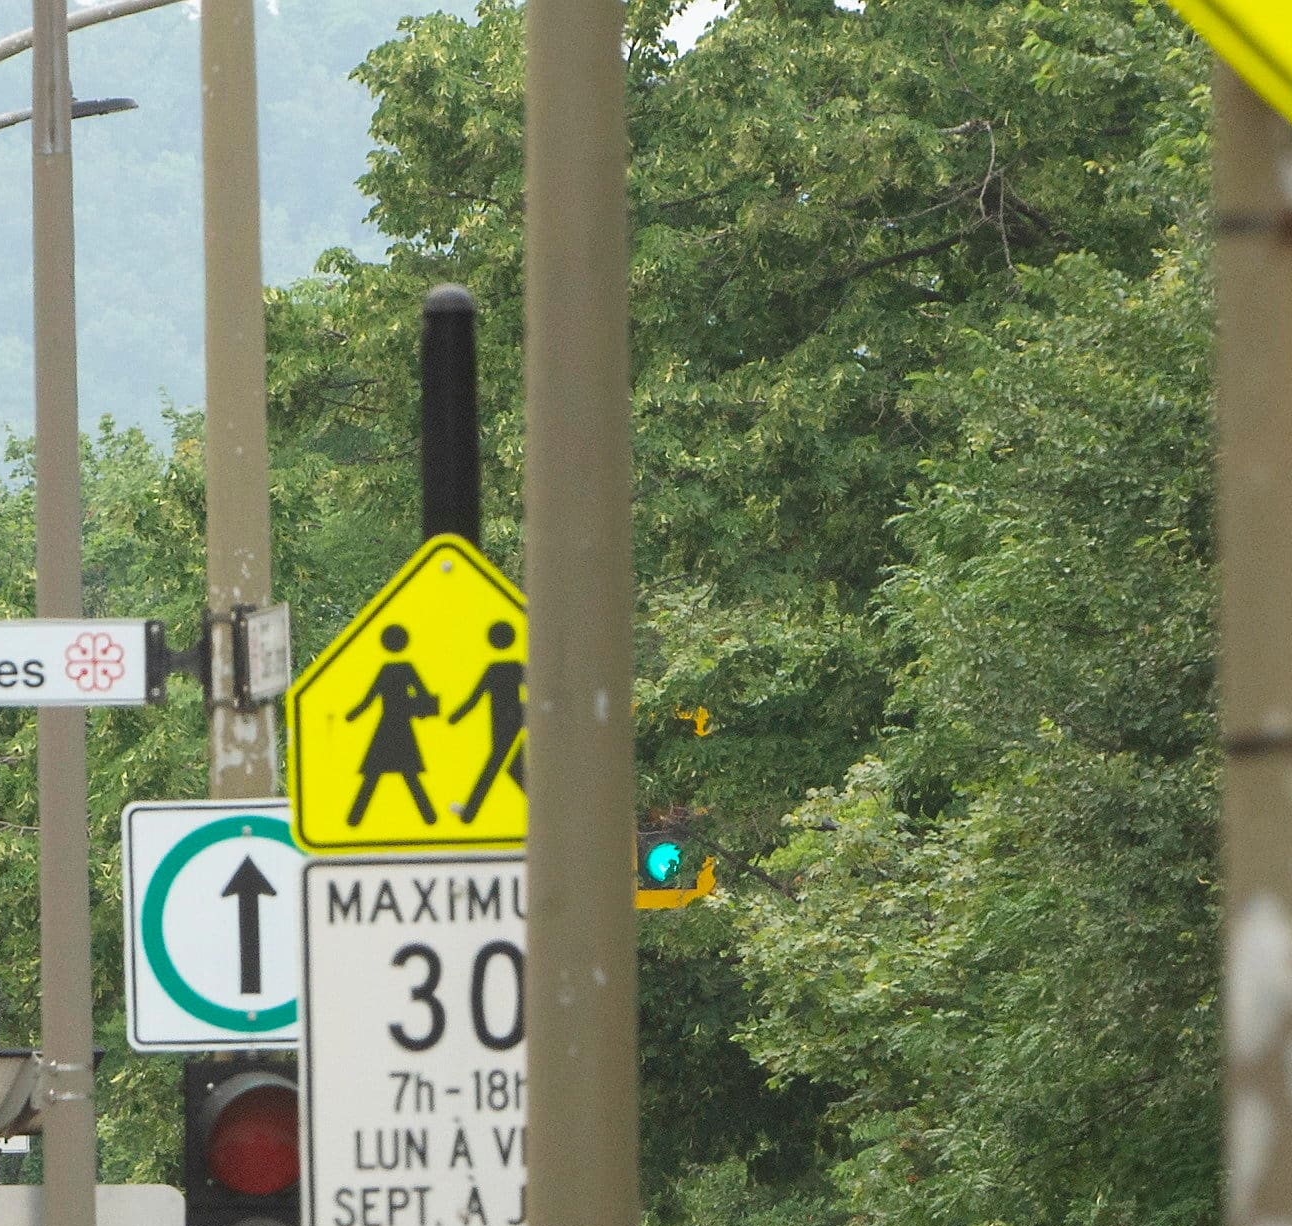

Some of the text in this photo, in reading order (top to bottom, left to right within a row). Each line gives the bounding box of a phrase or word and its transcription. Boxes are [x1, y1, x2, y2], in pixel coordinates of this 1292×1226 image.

[327, 877, 527, 924] MAXIM
[389, 940, 527, 1051] 30
[355, 1127, 428, 1170] LUN
[449, 1116, 473, 1170] À
[465, 1174, 487, 1226] À
